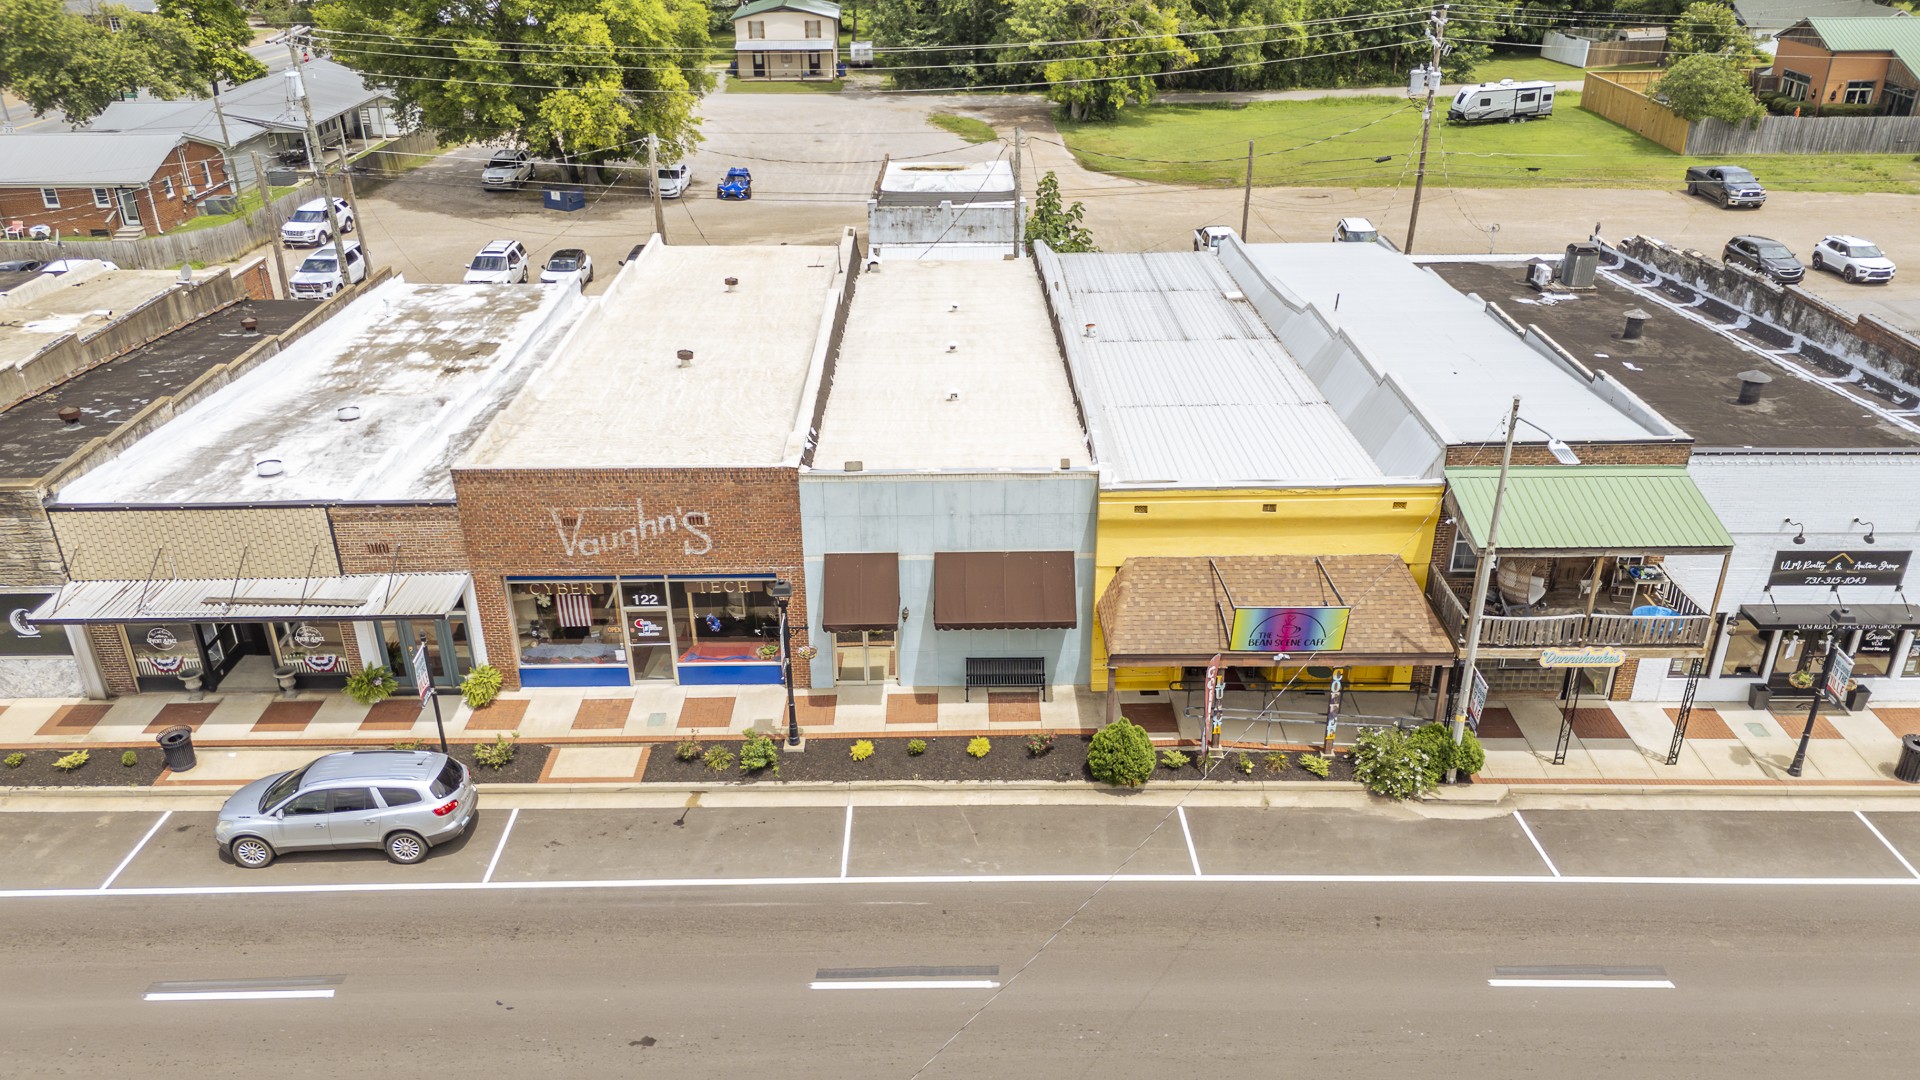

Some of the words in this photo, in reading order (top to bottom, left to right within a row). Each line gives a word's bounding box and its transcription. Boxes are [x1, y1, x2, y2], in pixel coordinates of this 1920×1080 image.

[1803, 561, 1827, 572] Realty
[1835, 562, 1843, 571] &
[1853, 561, 1878, 571] Auction
[1878, 562, 1900, 572] Group
[1804, 576, 1867, 585] 731-315-1043
[529, 583, 597, 596] CYBER
[696, 581, 751, 594] TECH
[632, 594, 659, 605] 122
[1248, 639, 1273, 647] BEAN
[1275, 639, 1301, 647] SCENE
